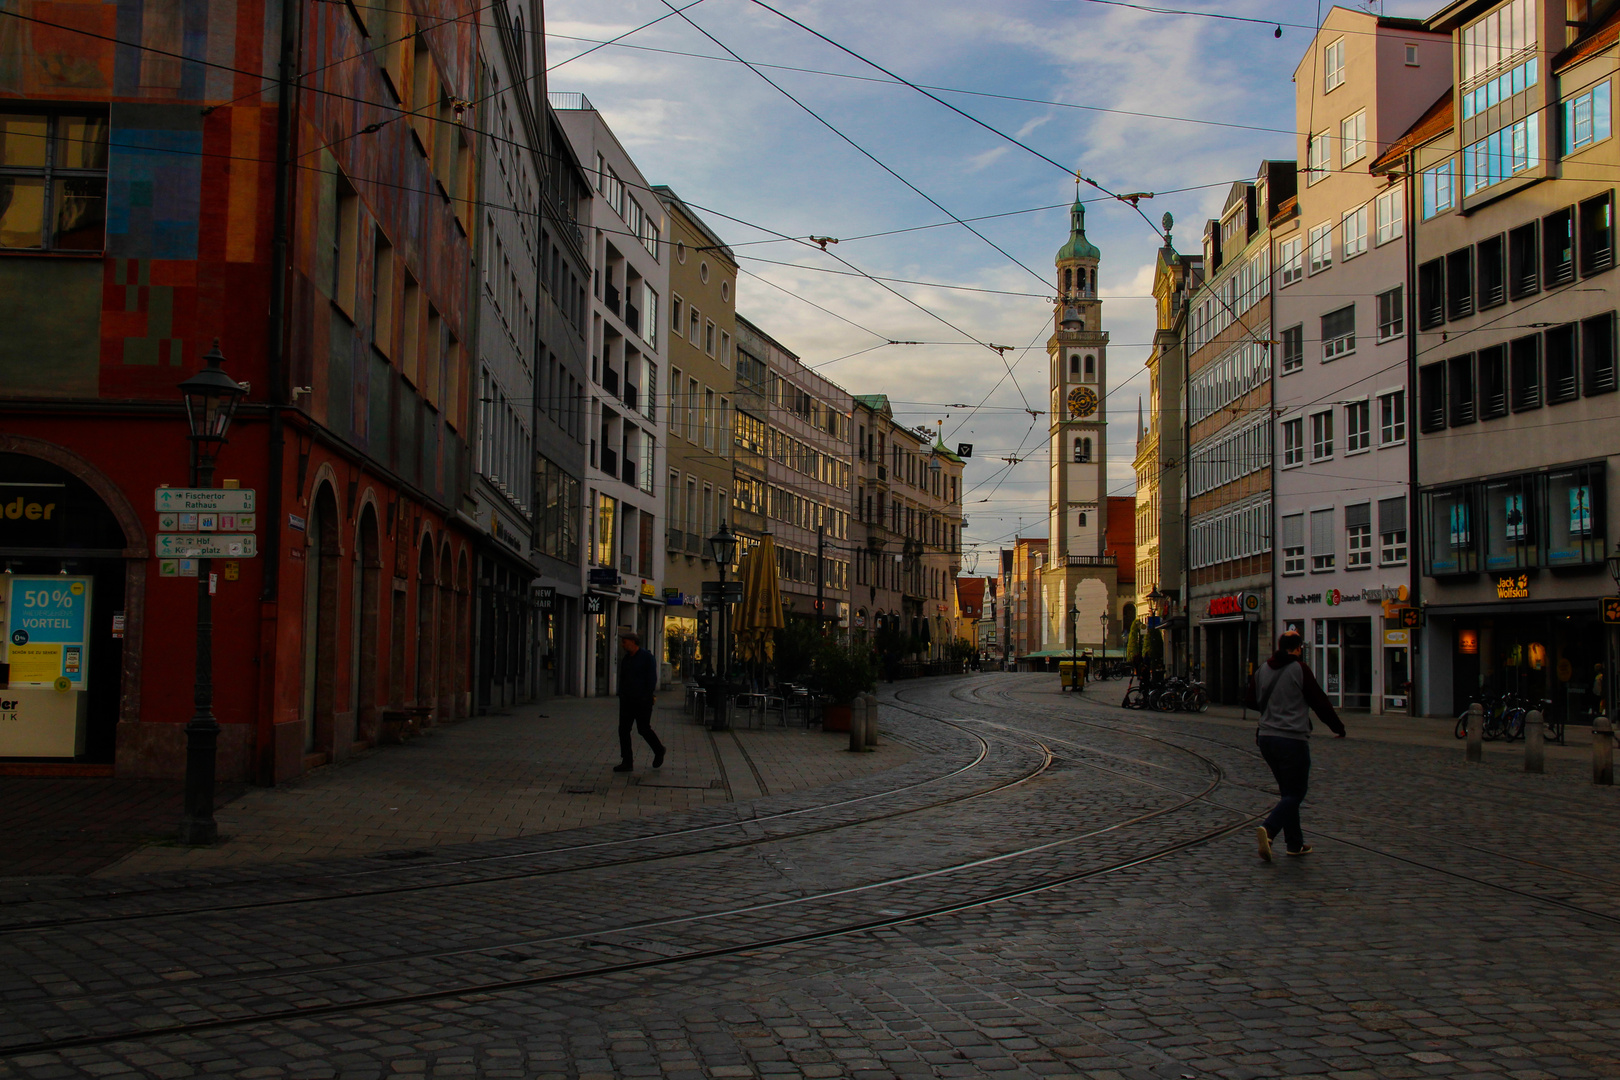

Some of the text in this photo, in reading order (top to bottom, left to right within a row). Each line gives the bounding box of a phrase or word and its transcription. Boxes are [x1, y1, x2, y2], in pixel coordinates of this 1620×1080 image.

[185, 492, 225, 500] Fischertor
[1496, 576, 1515, 588] Jack
[535, 589, 551, 597] NEW
[1497, 587, 1528, 598] Wolfskin
[534, 600, 551, 608] HAIR
[22, 618, 72, 629] VORTEIL
[0, 697, 18, 710] er
